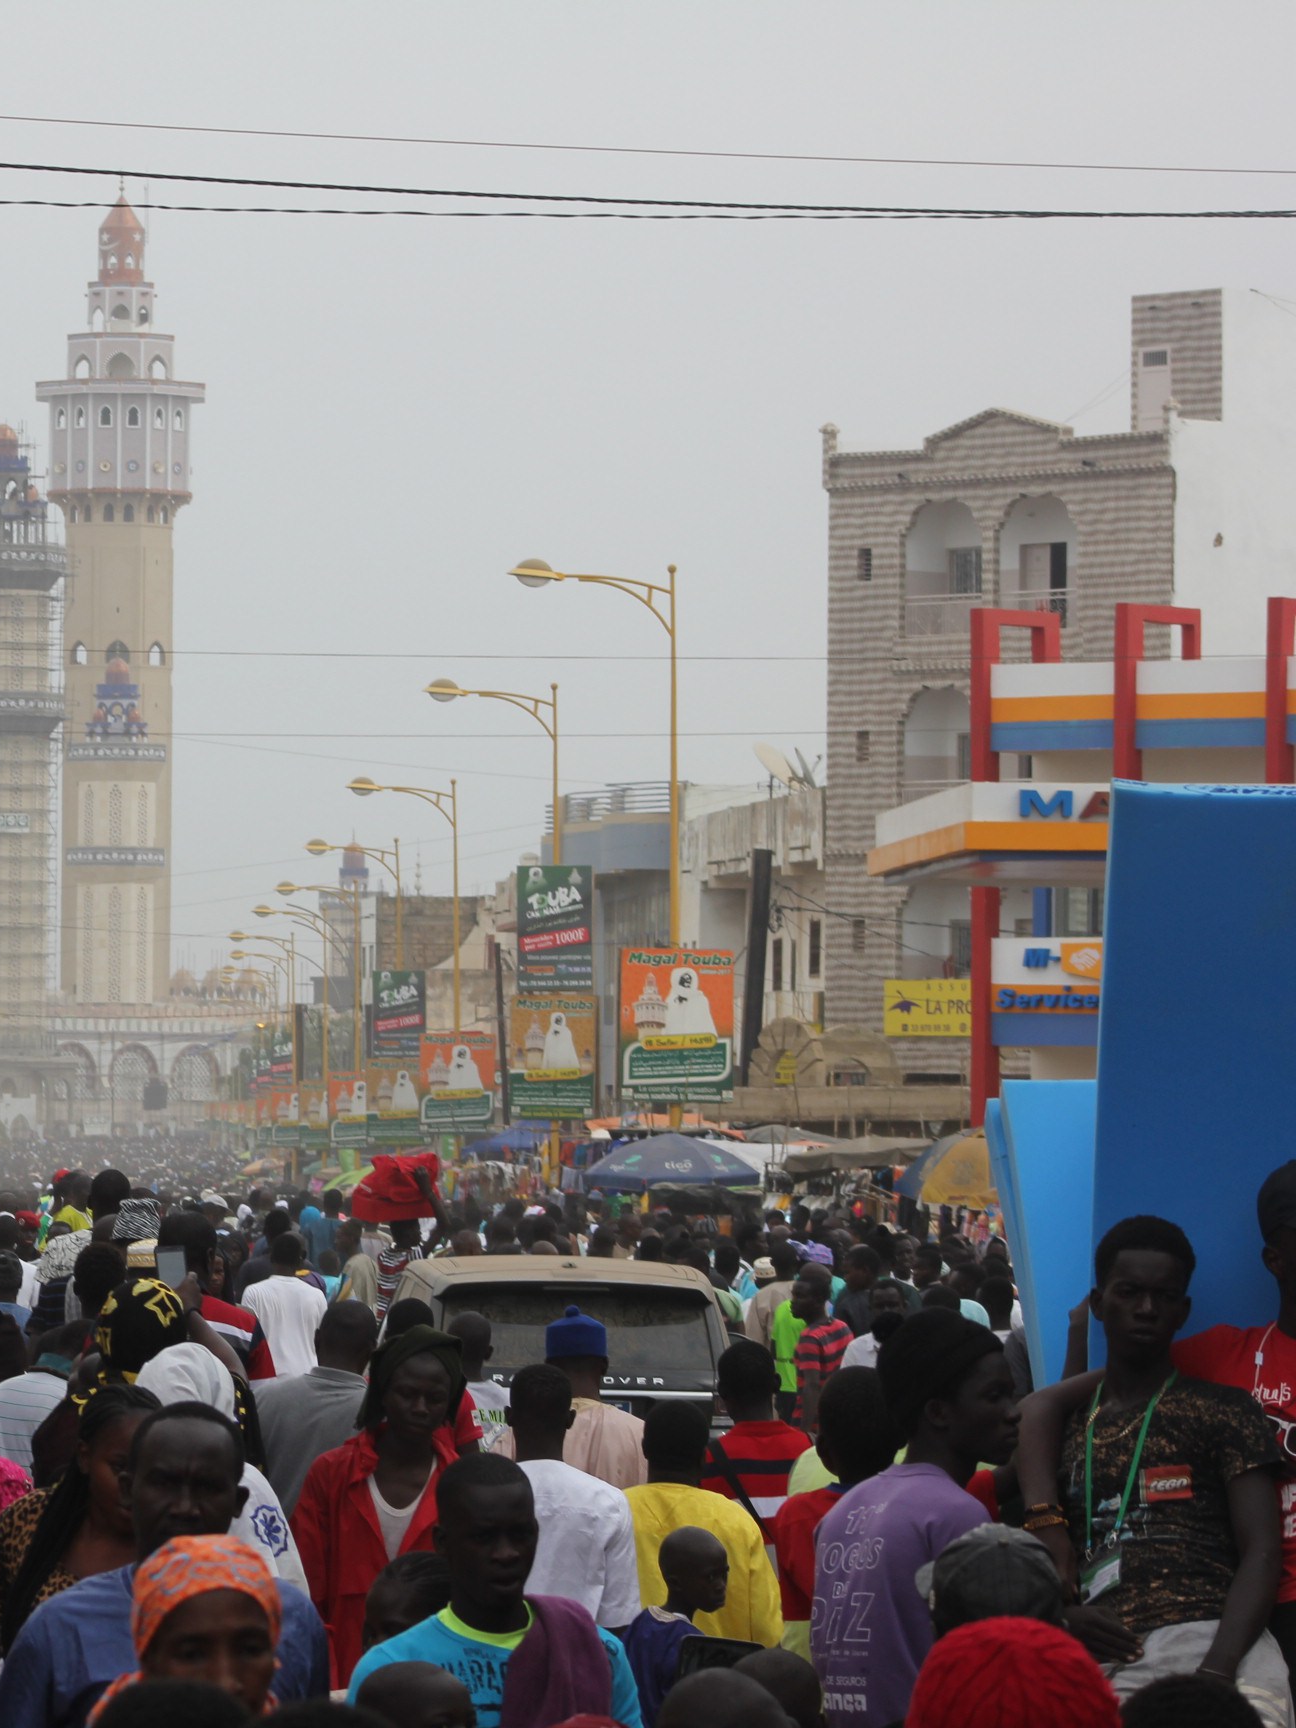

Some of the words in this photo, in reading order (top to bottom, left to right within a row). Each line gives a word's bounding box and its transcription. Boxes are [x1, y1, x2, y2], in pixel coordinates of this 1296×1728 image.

[527, 885, 582, 909] TOUBA
[555, 928, 585, 944] 1000F
[628, 951, 678, 966] Magal
[682, 953, 732, 966] Touba
[516, 999, 552, 1010] Magal
[556, 1000, 593, 1010] Touba
[995, 985, 1100, 1009] Service
[926, 999, 943, 1015] LA
[664, 1159, 693, 1173] tigo
[603, 1376, 665, 1386] OVER
[1150, 1476, 1190, 1492] LEGO
